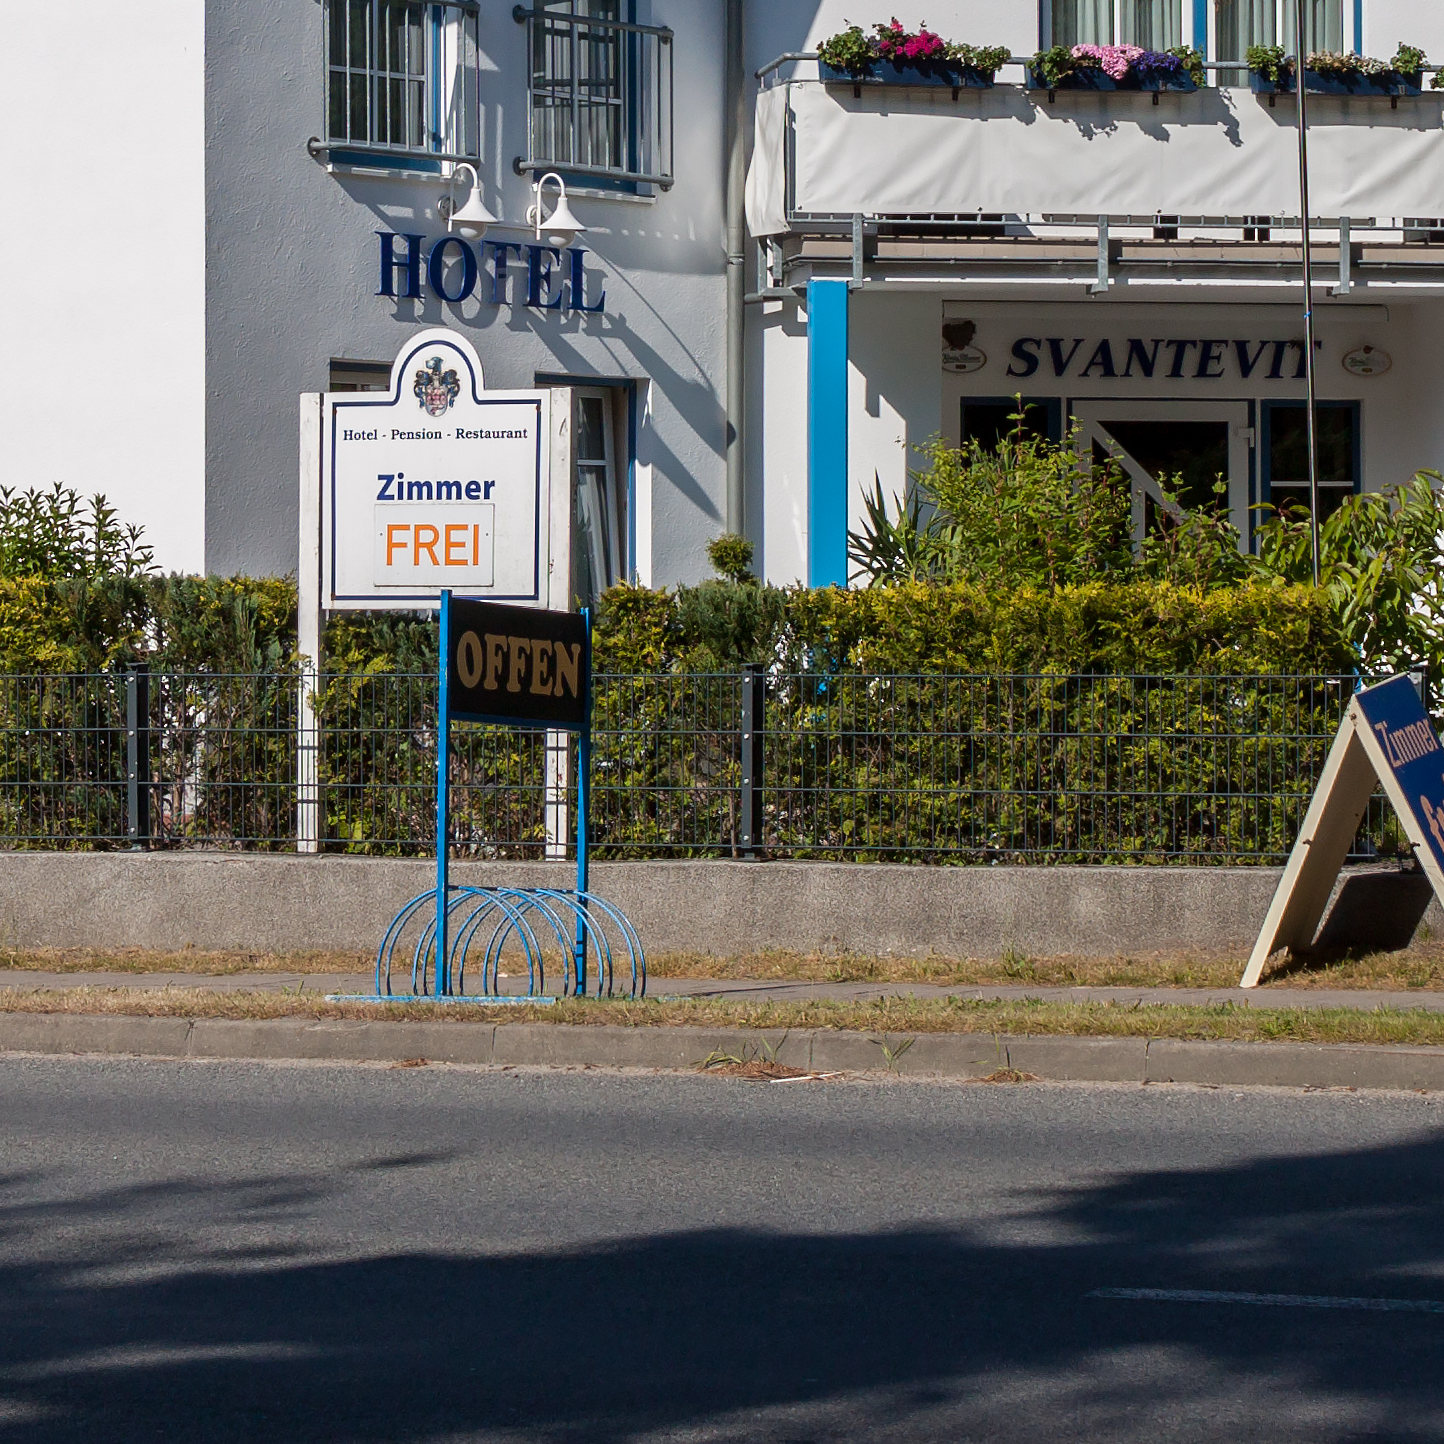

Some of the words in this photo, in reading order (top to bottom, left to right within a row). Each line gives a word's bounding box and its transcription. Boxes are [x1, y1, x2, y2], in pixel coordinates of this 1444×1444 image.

[375, 232, 606, 313] HOTEL
[1006, 338, 1322, 379] SVANTEVIT
[343, 429, 378, 440] Hotel
[391, 428, 442, 440] Pension
[455, 428, 528, 440] Restaurant
[376, 472, 495, 501] Zimmer
[386, 524, 480, 566] FREI
[457, 631, 581, 698] OFFEN
[1376, 719, 1439, 768] Zimmer
